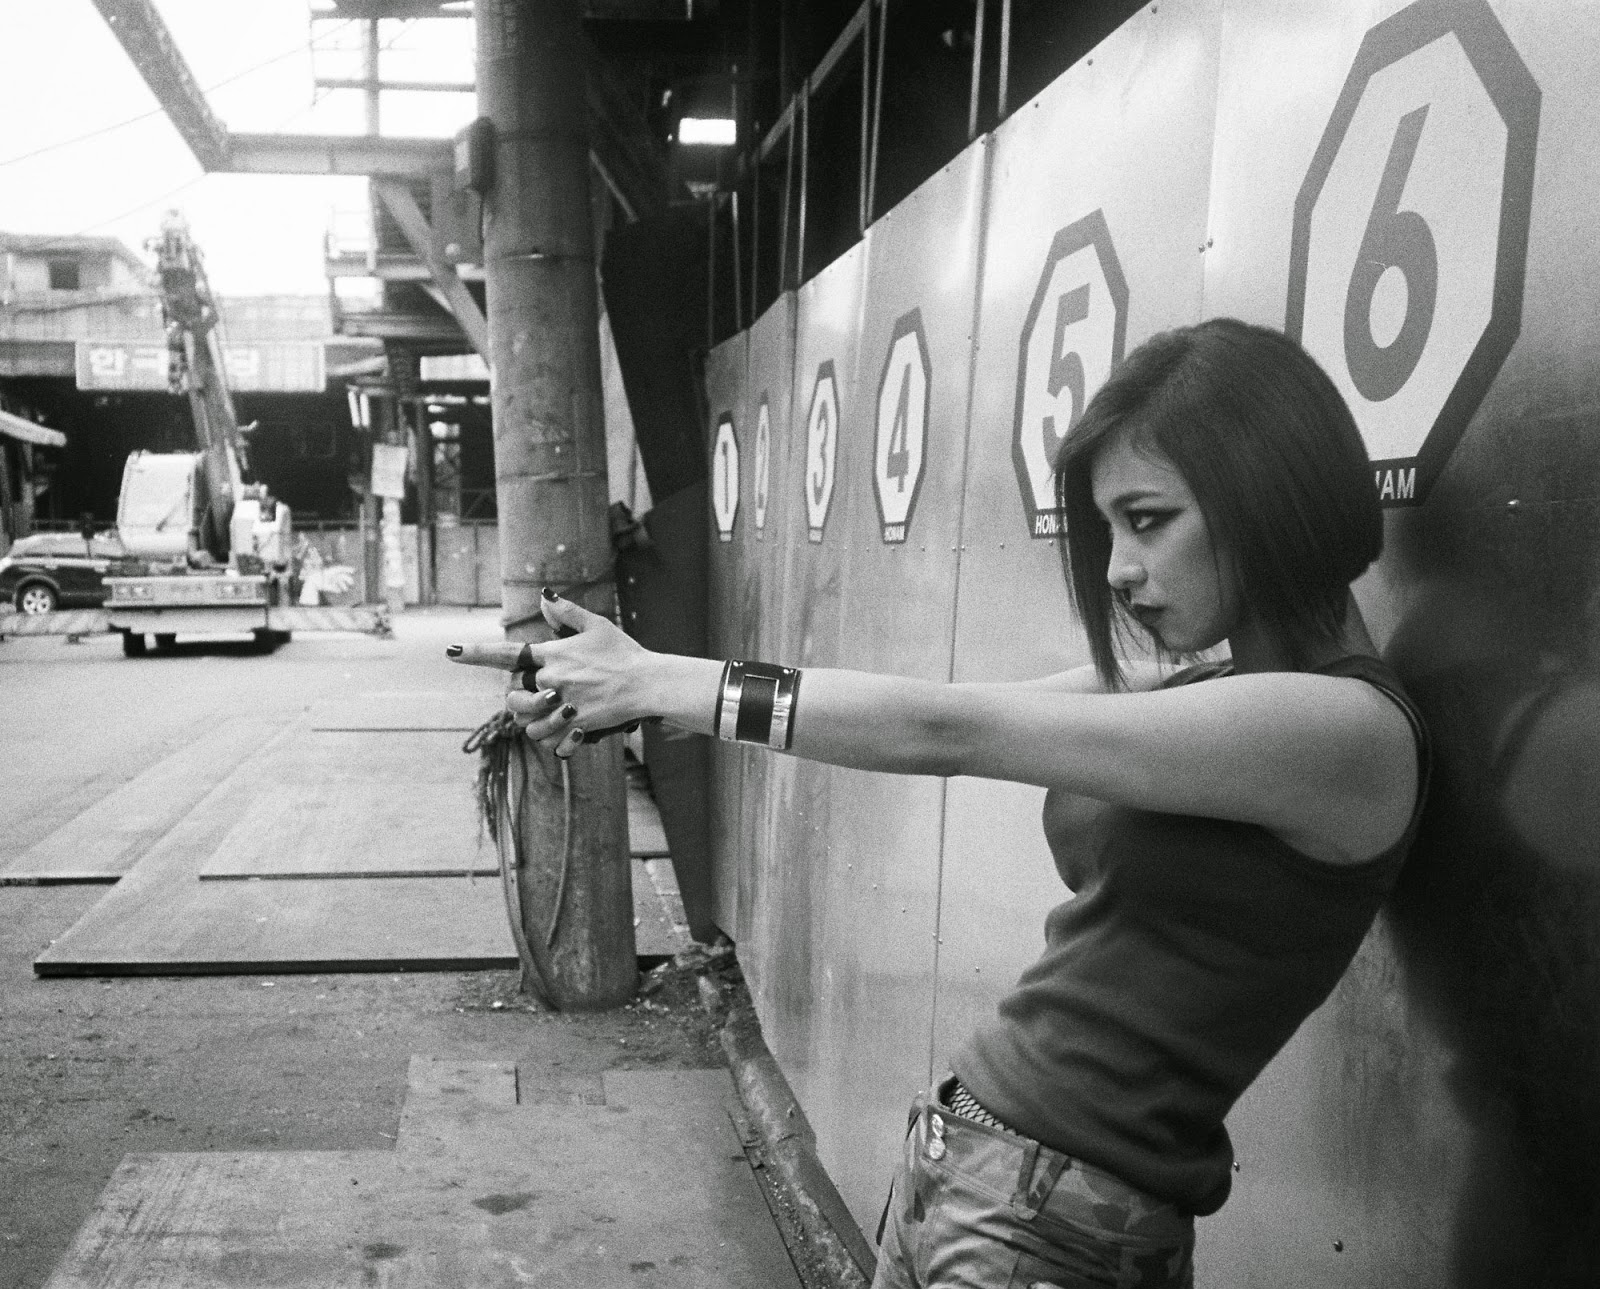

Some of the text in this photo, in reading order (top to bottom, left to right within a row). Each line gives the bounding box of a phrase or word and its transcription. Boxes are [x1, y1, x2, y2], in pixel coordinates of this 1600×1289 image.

[1343, 103, 1438, 402] 6
[886, 363, 911, 492] 4
[1042, 283, 1091, 473] 5
[721, 440, 729, 514] 1
[813, 400, 829, 506] 3
